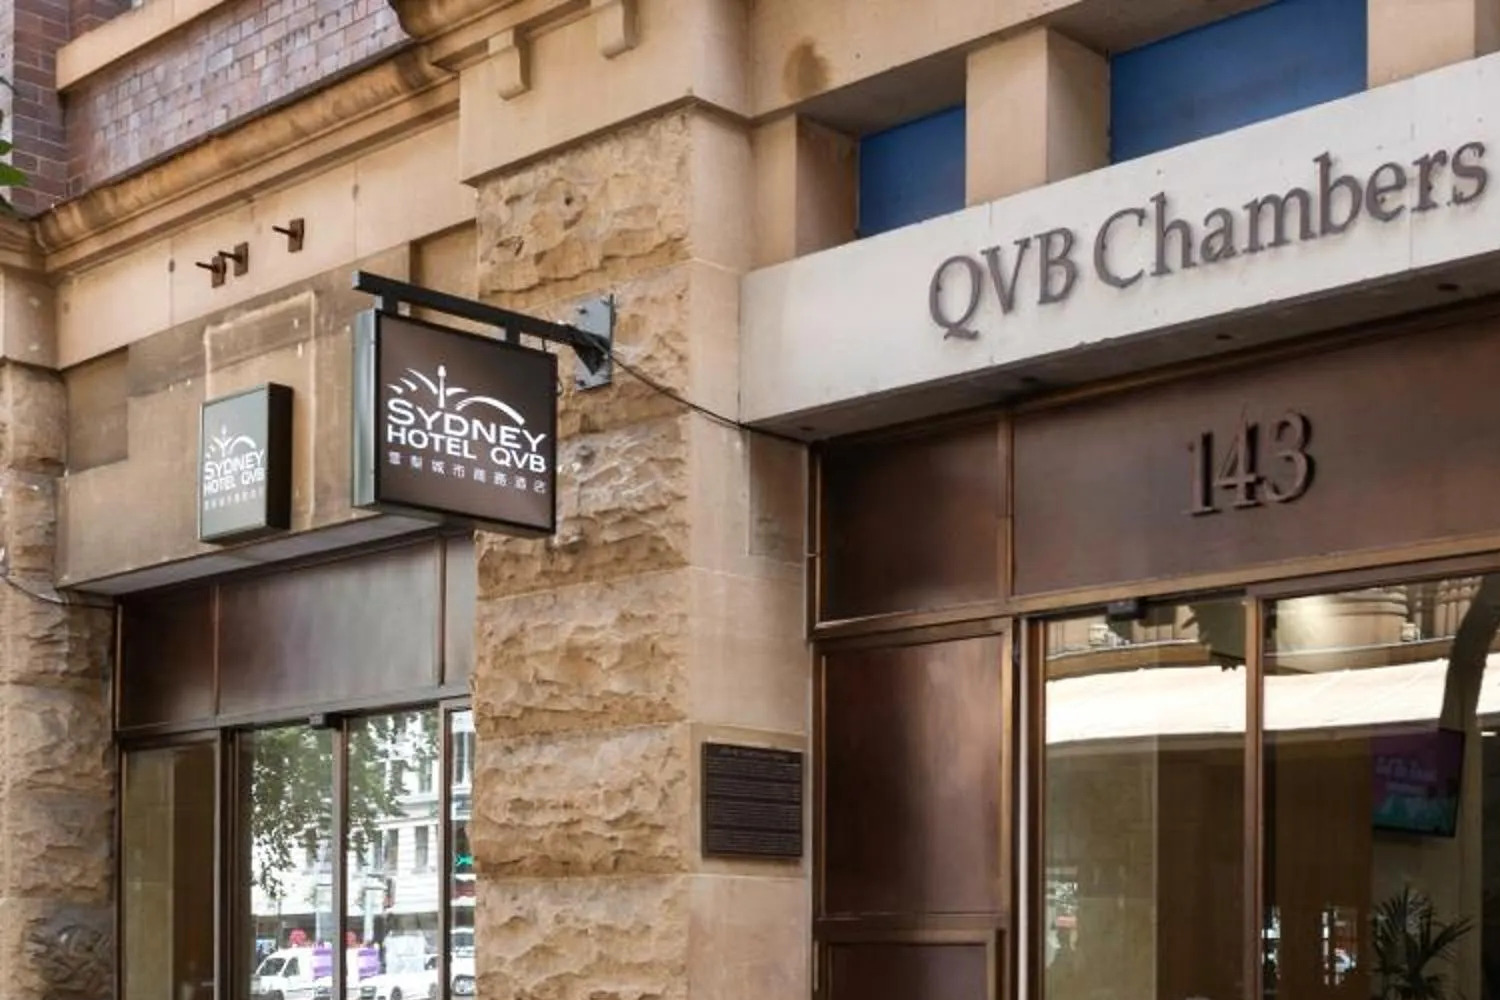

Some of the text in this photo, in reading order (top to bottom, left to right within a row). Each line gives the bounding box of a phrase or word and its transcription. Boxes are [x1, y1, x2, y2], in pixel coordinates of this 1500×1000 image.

[929, 141, 1488, 341] QVB Chambers
[387, 398, 548, 452] SYDNEY
[387, 424, 547, 474] HOTEL QVB
[203, 467, 265, 497] HOTEL QVB
[204, 449, 265, 480] SYDNEY
[1187, 408, 1316, 518] 143
